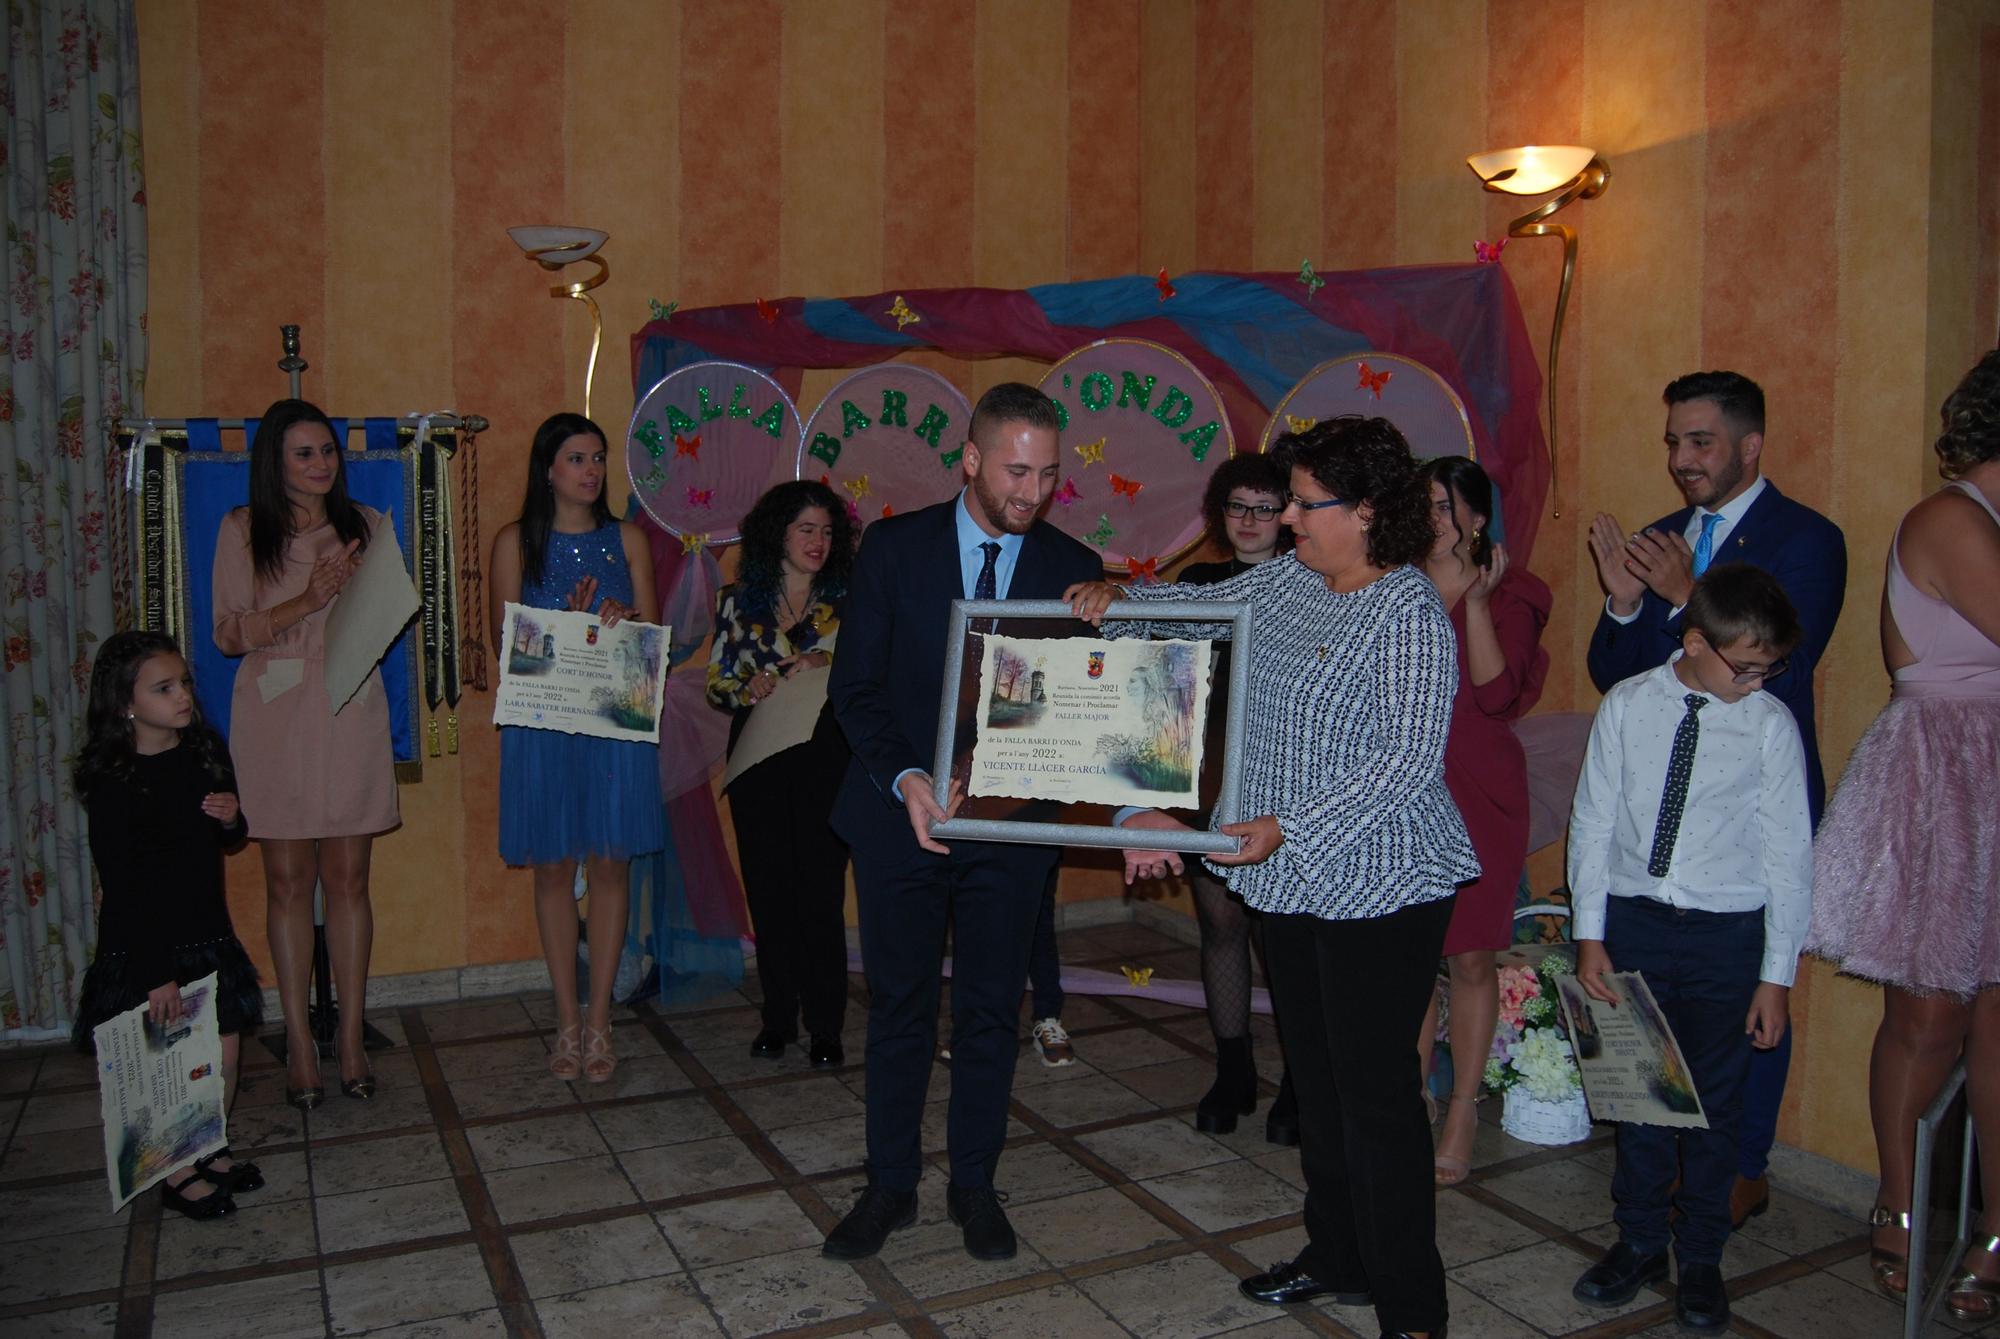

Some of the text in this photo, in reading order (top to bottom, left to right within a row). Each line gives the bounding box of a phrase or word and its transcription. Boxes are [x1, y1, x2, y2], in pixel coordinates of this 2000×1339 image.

[633, 383, 785, 459] FALLA
[146, 469, 162, 520] Claudia
[556, 667, 576, 676] CORT
[522, 681, 539, 689] FALLA
[1099, 684, 1119, 693] 2021
[543, 692, 562, 701] 2022
[505, 699, 527, 708] LARA
[527, 702, 560, 711] SABATER
[1055, 712, 1110, 721] FALLER MAJOR
[1028, 737, 1050, 745] BARRI
[1032, 748, 1057, 759] 2022
[983, 761, 1026, 771] VICENTE
[1068, 763, 1107, 775] GARCÍA
